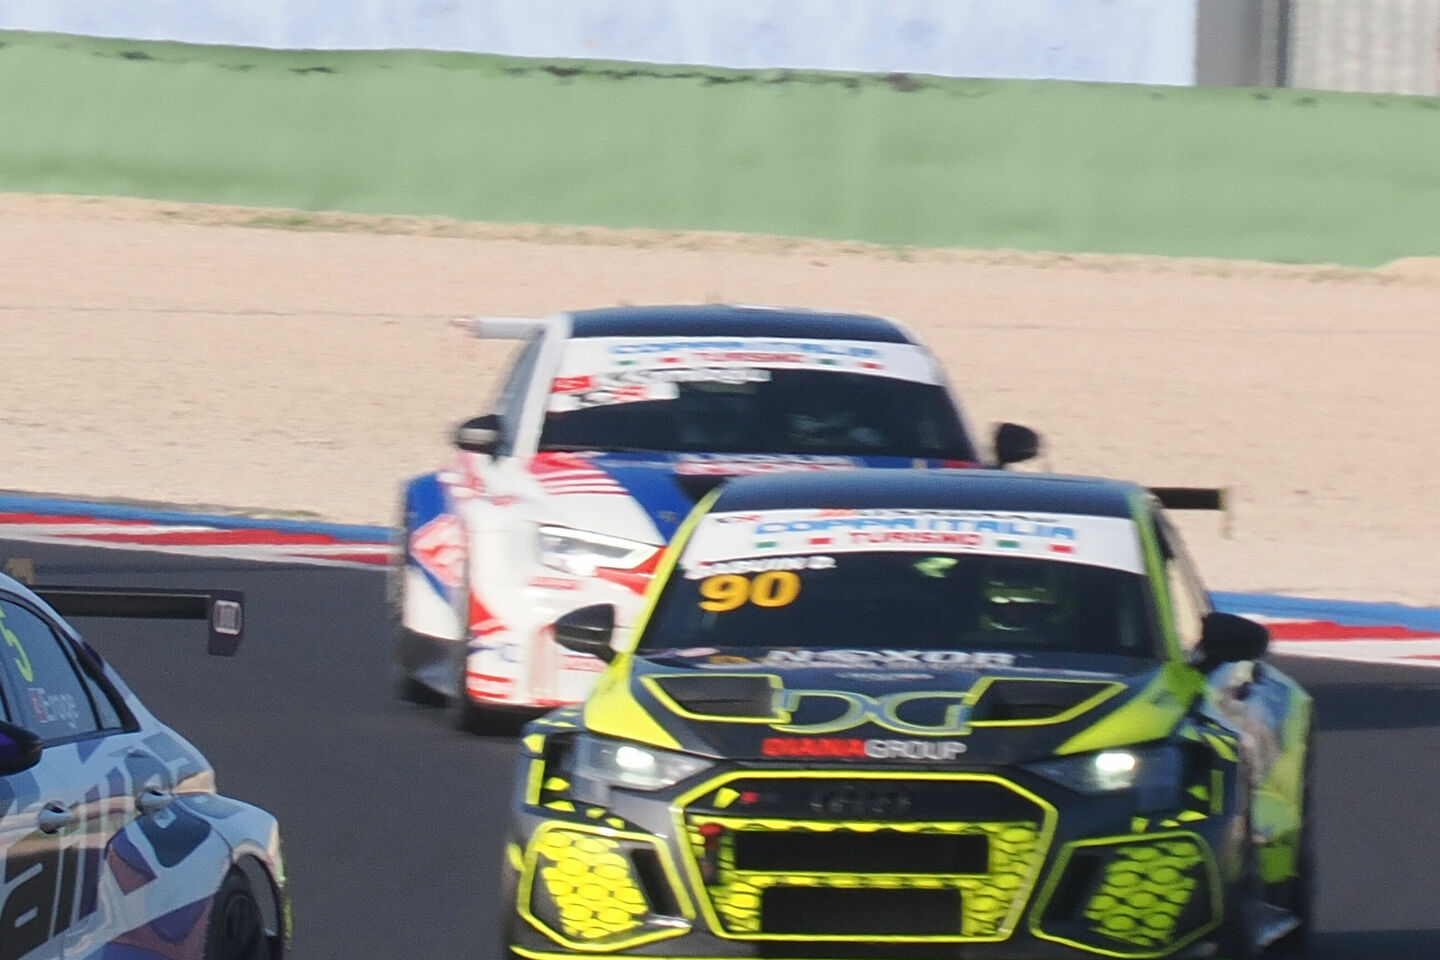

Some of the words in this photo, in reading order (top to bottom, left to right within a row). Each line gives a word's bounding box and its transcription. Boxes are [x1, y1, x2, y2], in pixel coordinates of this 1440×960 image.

[755, 517, 916, 535] COPPA
[928, 518, 1076, 541] ITALIA
[848, 531, 983, 546] TURISMO
[698, 570, 802, 612] 90
